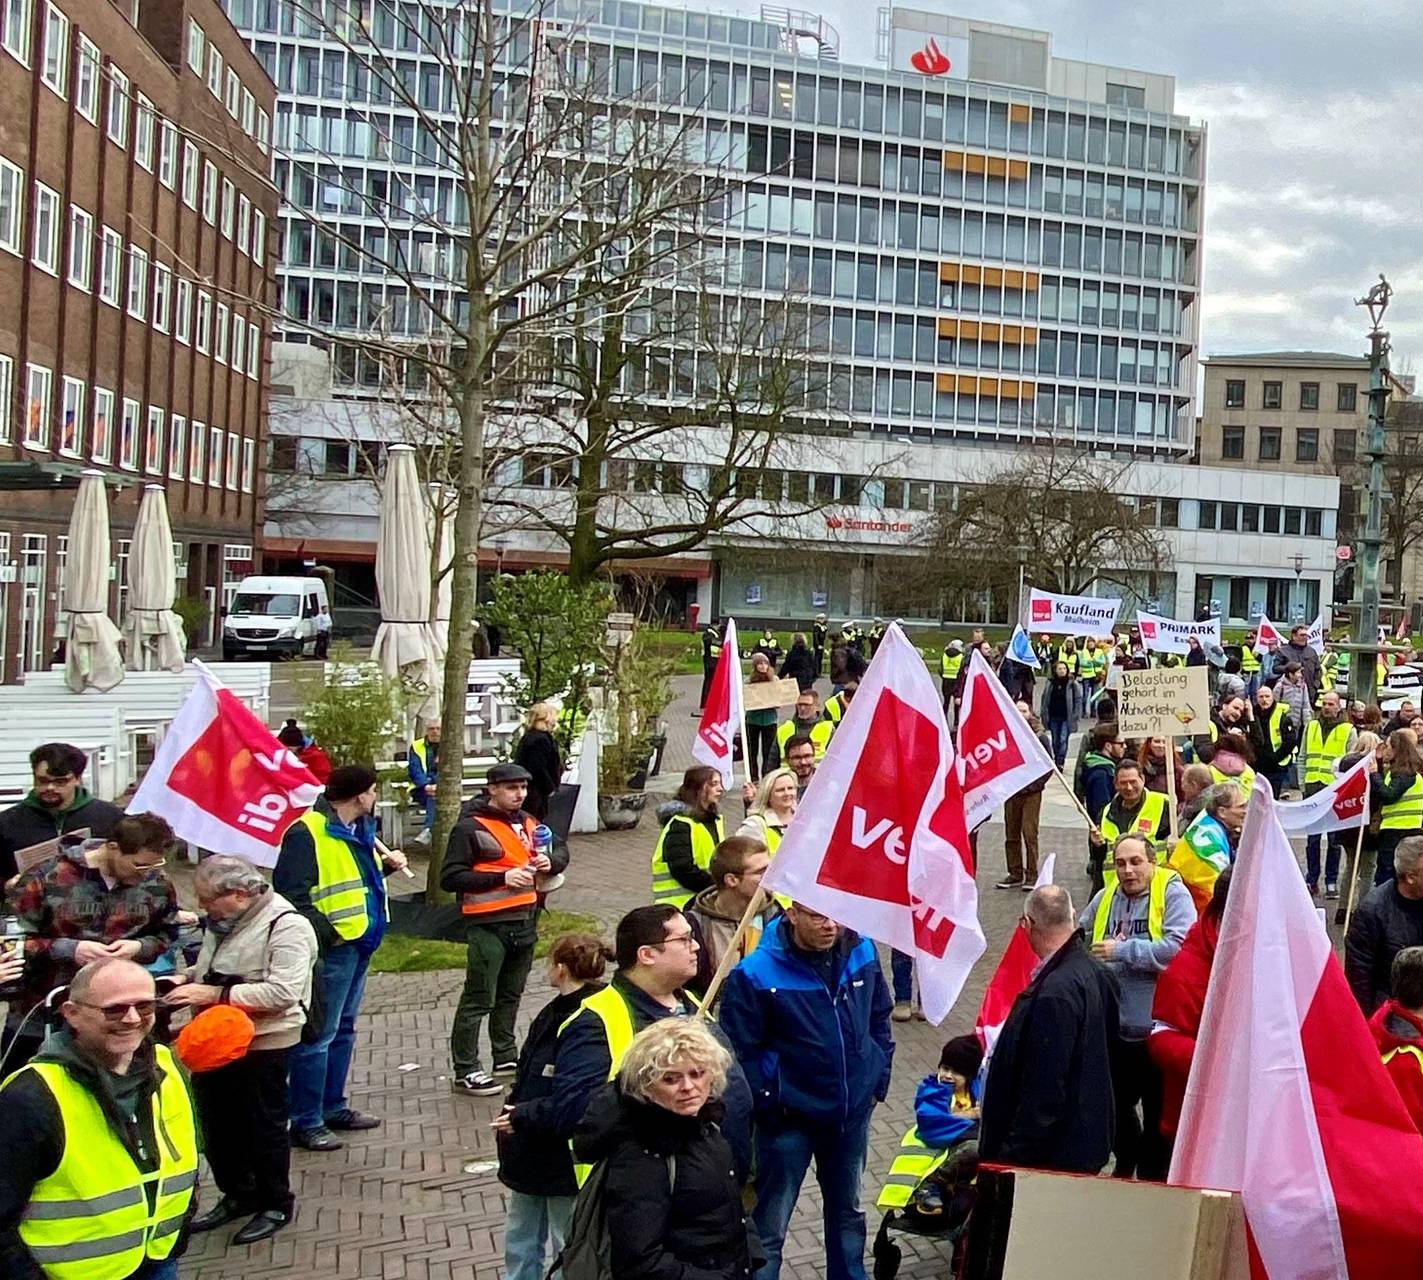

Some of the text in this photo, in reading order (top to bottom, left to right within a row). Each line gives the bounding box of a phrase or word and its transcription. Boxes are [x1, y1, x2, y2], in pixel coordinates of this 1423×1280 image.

[845, 518, 912, 532] Santander
[1055, 602, 1115, 619] Kaufland
[1122, 672, 1188, 689] Belastung
[1163, 690, 1176, 698] im
[1335, 797, 1357, 810] ver
